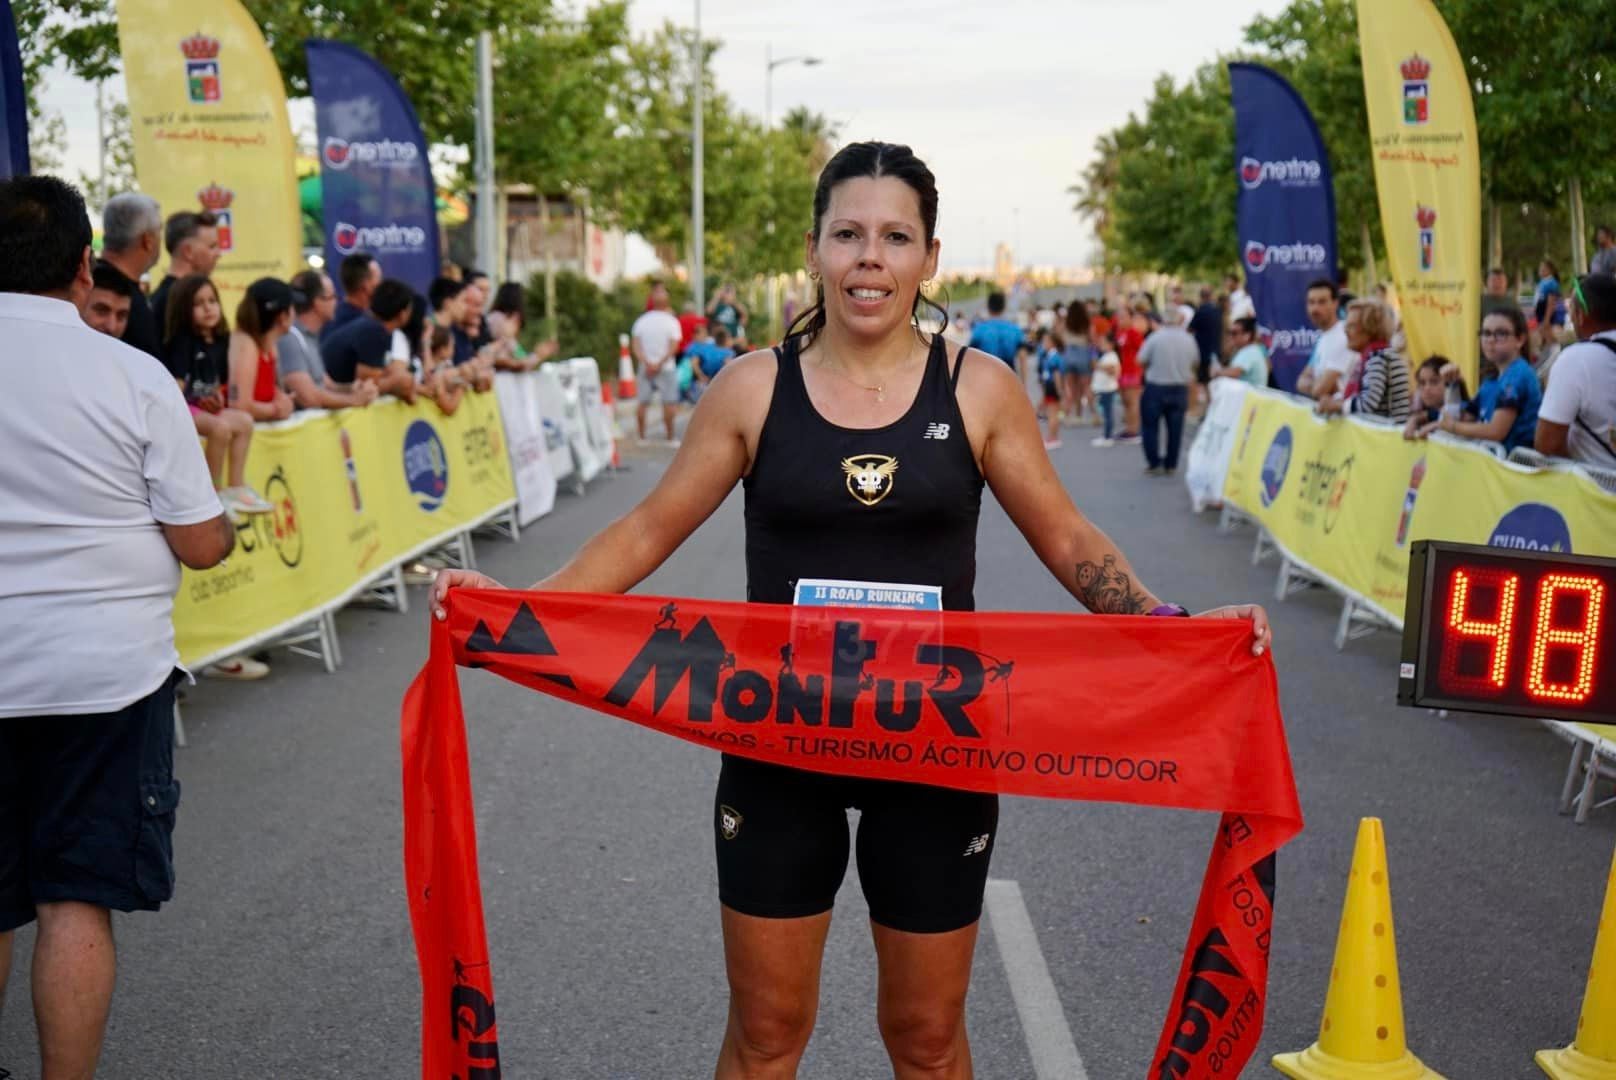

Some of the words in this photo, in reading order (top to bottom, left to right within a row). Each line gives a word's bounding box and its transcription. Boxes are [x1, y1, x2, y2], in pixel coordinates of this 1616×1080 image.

[815, 586, 827, 599] II
[829, 587, 864, 602] ROAD
[867, 590, 925, 605] RUNNING
[1449, 570, 1604, 701] 48
[784, 735, 912, 765] TURISMO
[921, 740, 1026, 773] ÁCTIVO
[1034, 752, 1178, 783] OUTDOOR
